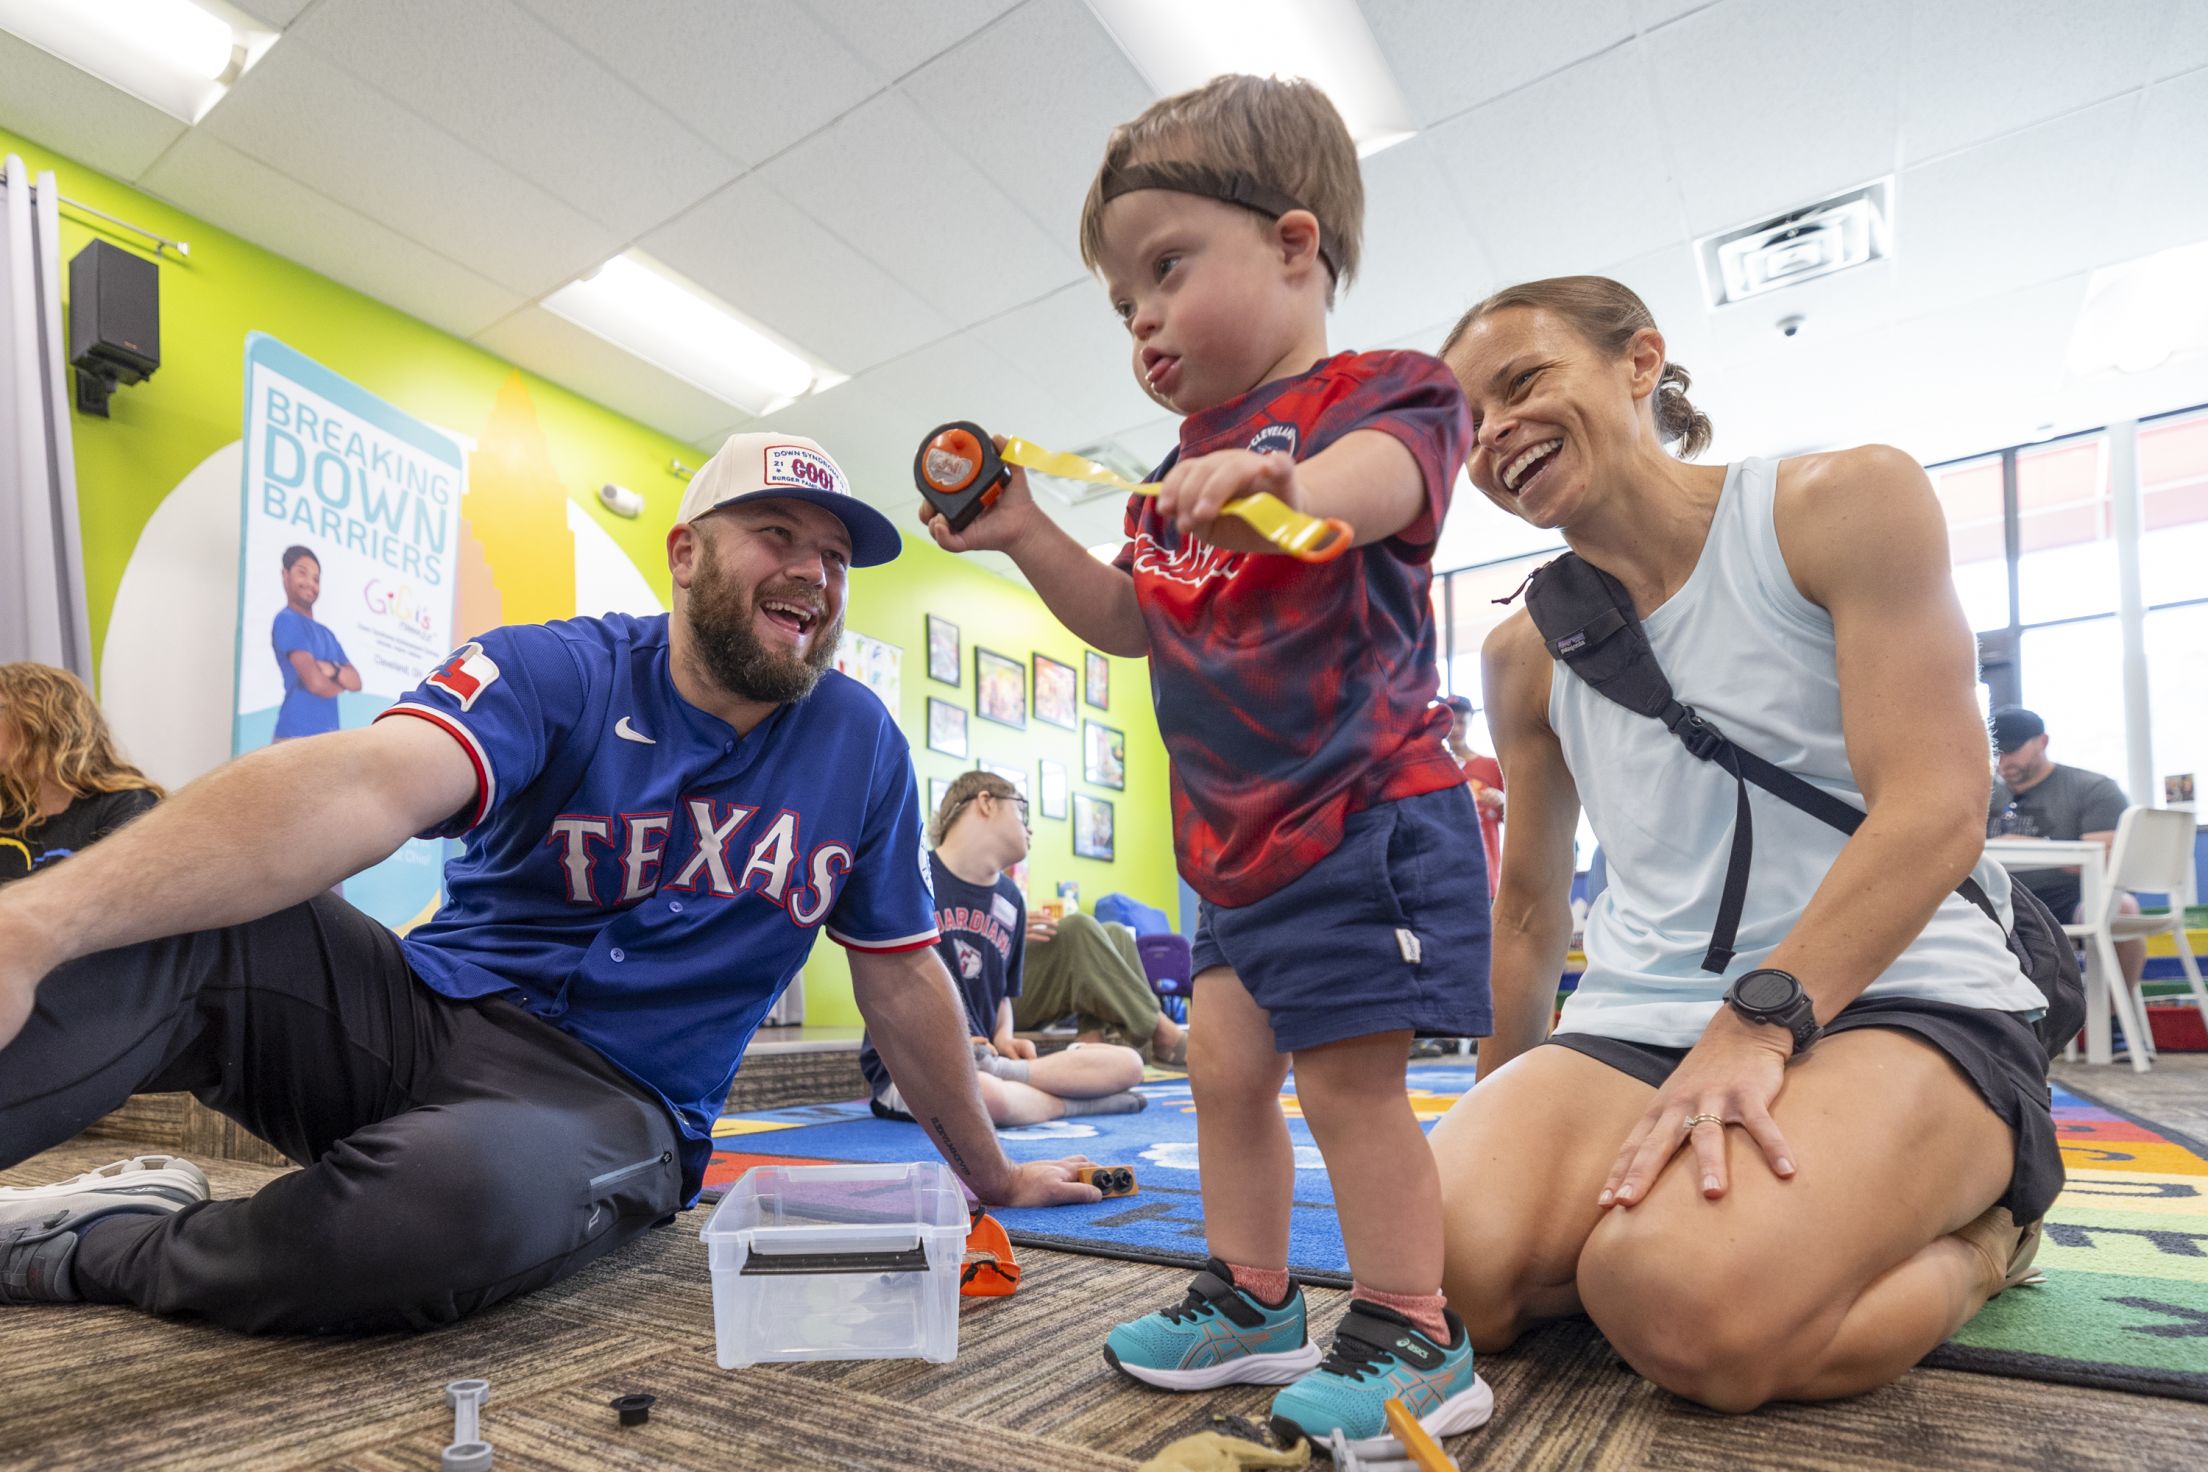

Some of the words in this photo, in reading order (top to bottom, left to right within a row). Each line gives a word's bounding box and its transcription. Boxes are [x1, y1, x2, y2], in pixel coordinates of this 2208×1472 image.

[264, 423, 447, 554] DOWN
[266, 386, 449, 505] BREAKING
[772, 475, 800, 483] BURGER
[774, 450, 800, 458] DOWN
[263, 481, 441, 586] BARRIERS
[547, 795, 854, 929] TEXAS
